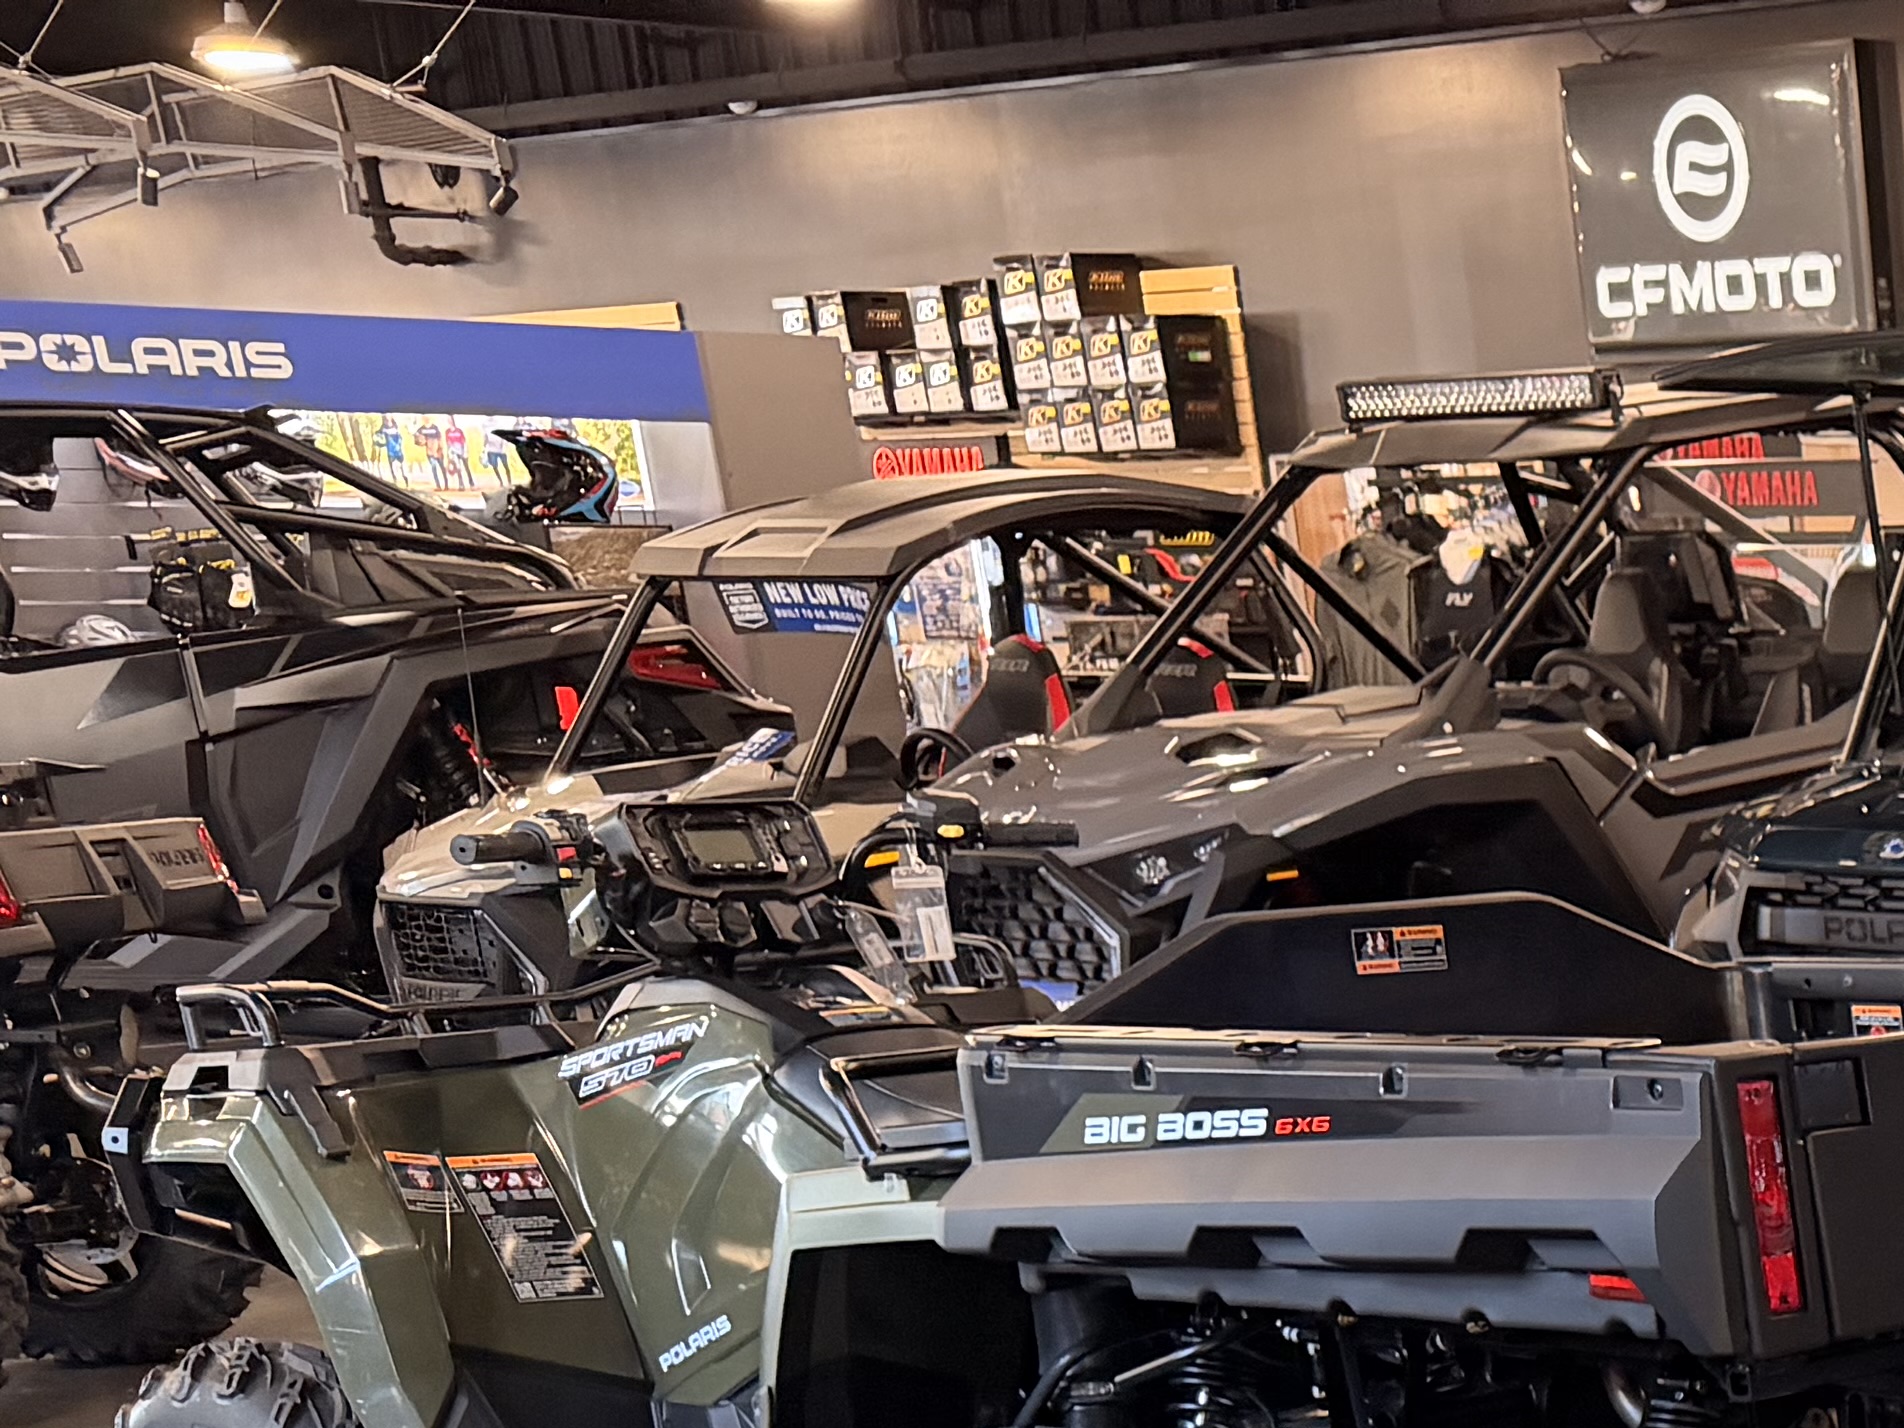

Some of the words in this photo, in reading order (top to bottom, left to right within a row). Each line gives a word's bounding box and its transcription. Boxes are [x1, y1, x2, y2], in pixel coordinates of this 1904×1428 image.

[1596, 253, 1840, 319] CFMOTO
[0, 332, 293, 380] POLARIS
[898, 447, 984, 476] YAMAHA
[1723, 470, 1819, 506] YAMAHA
[764, 582, 801, 604] NEW
[803, 583, 842, 606] LOW
[1446, 592, 1472, 607] FLY
[558, 1018, 708, 1077] SPORTSMAN
[577, 1056, 656, 1099] 570
[1083, 1114, 1146, 1144] BIG
[1156, 1107, 1269, 1142] BOSS
[658, 1315, 732, 1372] POLARIS
